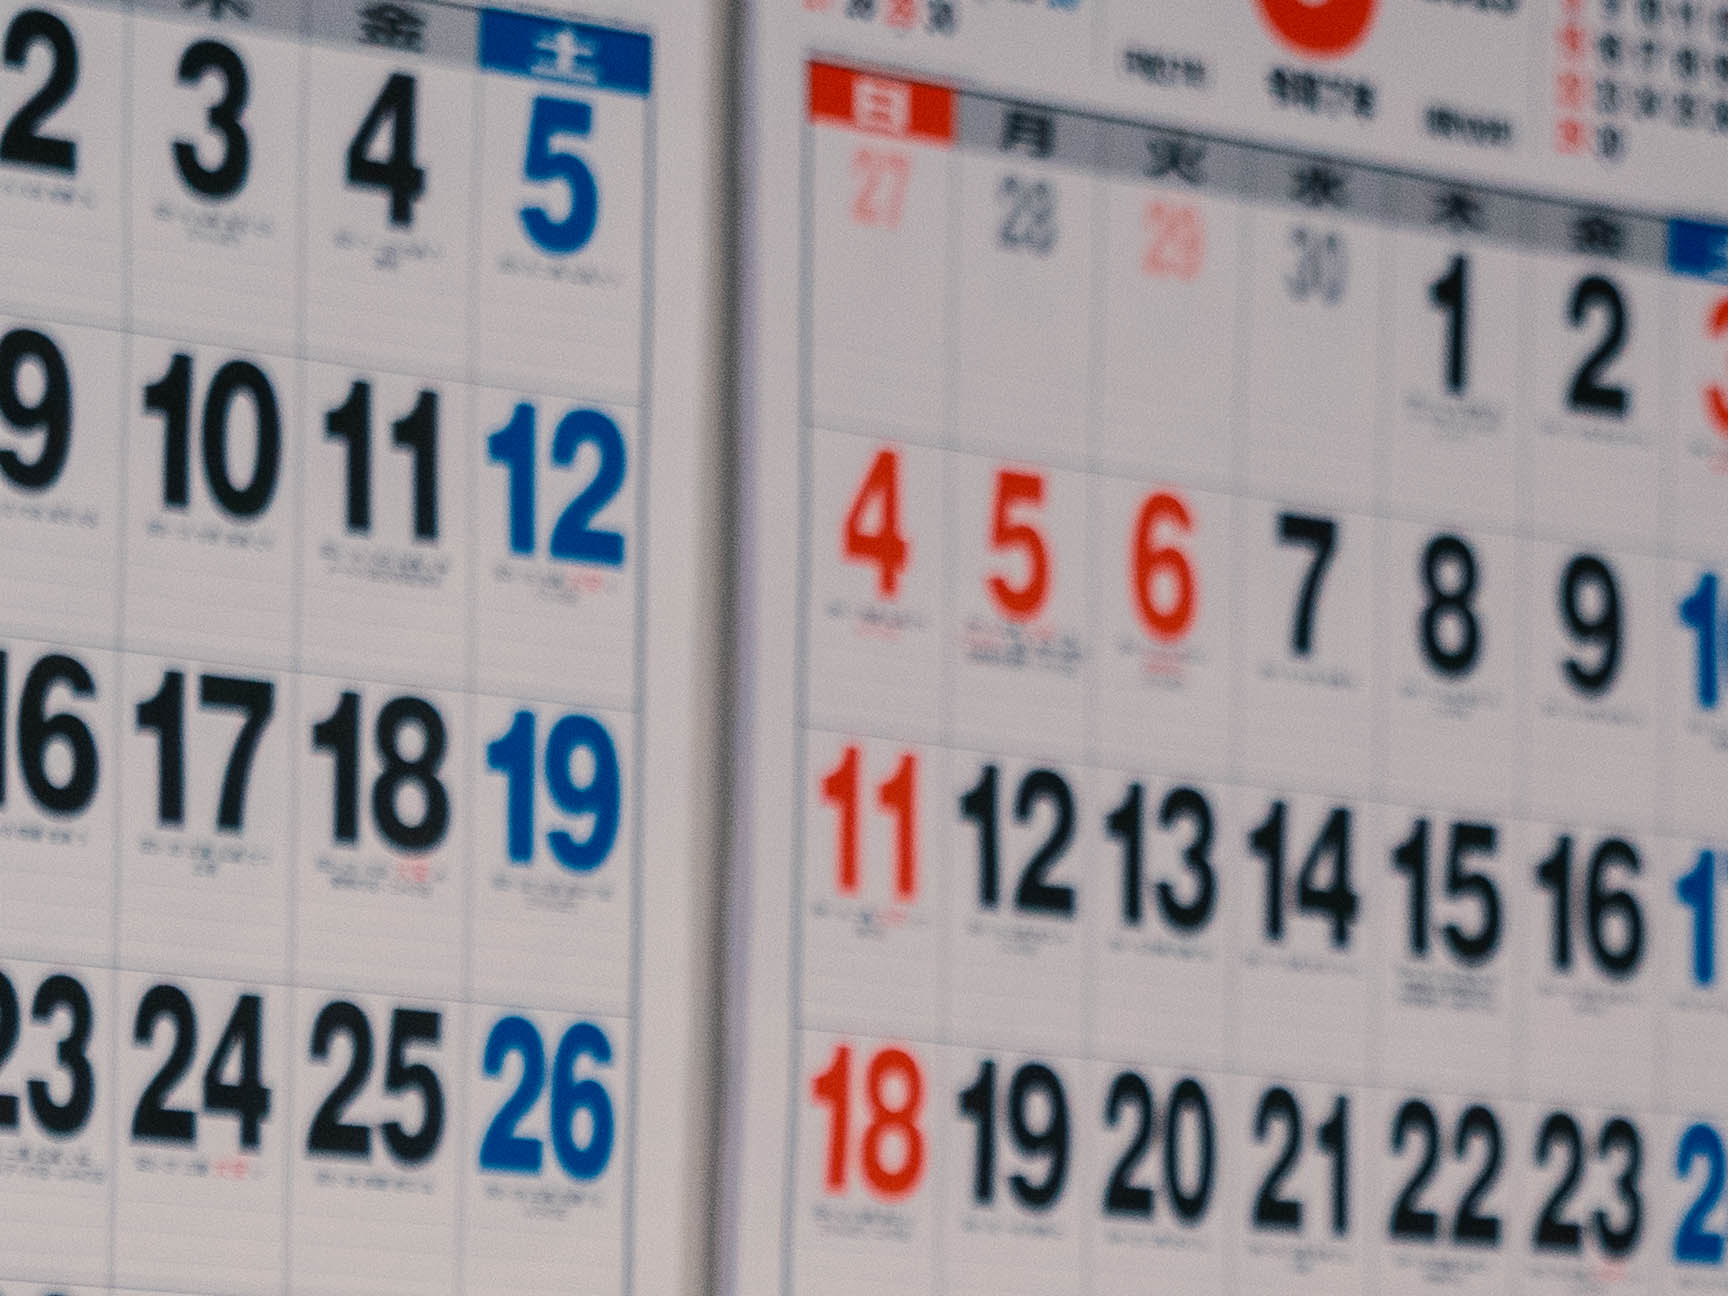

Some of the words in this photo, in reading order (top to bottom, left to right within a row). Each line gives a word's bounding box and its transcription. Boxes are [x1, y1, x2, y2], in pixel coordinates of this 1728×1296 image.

[0, 9, 78, 174] 2
[173, 39, 250, 200] 3
[346, 72, 425, 227] 4
[520, 95, 598, 254] 5
[852, 74, 910, 138] 日
[1431, 255, 1468, 393] 1
[1568, 275, 1628, 417] 2
[144, 353, 281, 519] 10
[325, 380, 438, 540] 11
[488, 402, 627, 566] 12
[844, 450, 907, 595] 4
[990, 471, 1048, 619] 5
[1133, 493, 1194, 639] 6
[1278, 512, 1337, 655] 7
[1421, 535, 1480, 677] 8
[1560, 554, 1622, 695] 9
[0, 650, 98, 816] 6
[136, 670, 274, 832] 17
[313, 691, 450, 853] 18
[487, 710, 621, 872] 19
[823, 747, 915, 897] 11
[960, 765, 1076, 917] 12
[1107, 783, 1216, 933] 13
[1249, 801, 1359, 947] 14
[1393, 819, 1502, 966] 15
[1537, 836, 1645, 979] 16
[132, 984, 271, 1149] 24
[307, 1001, 444, 1165] 25
[479, 1015, 614, 1180] 26
[814, 1047, 923, 1196] 18
[959, 1060, 1070, 1210] 19
[1104, 1072, 1215, 1223] 20
[1253, 1086, 1348, 1234] 21
[1389, 1099, 1503, 1246] 22
[1533, 1112, 1643, 1258] 23
